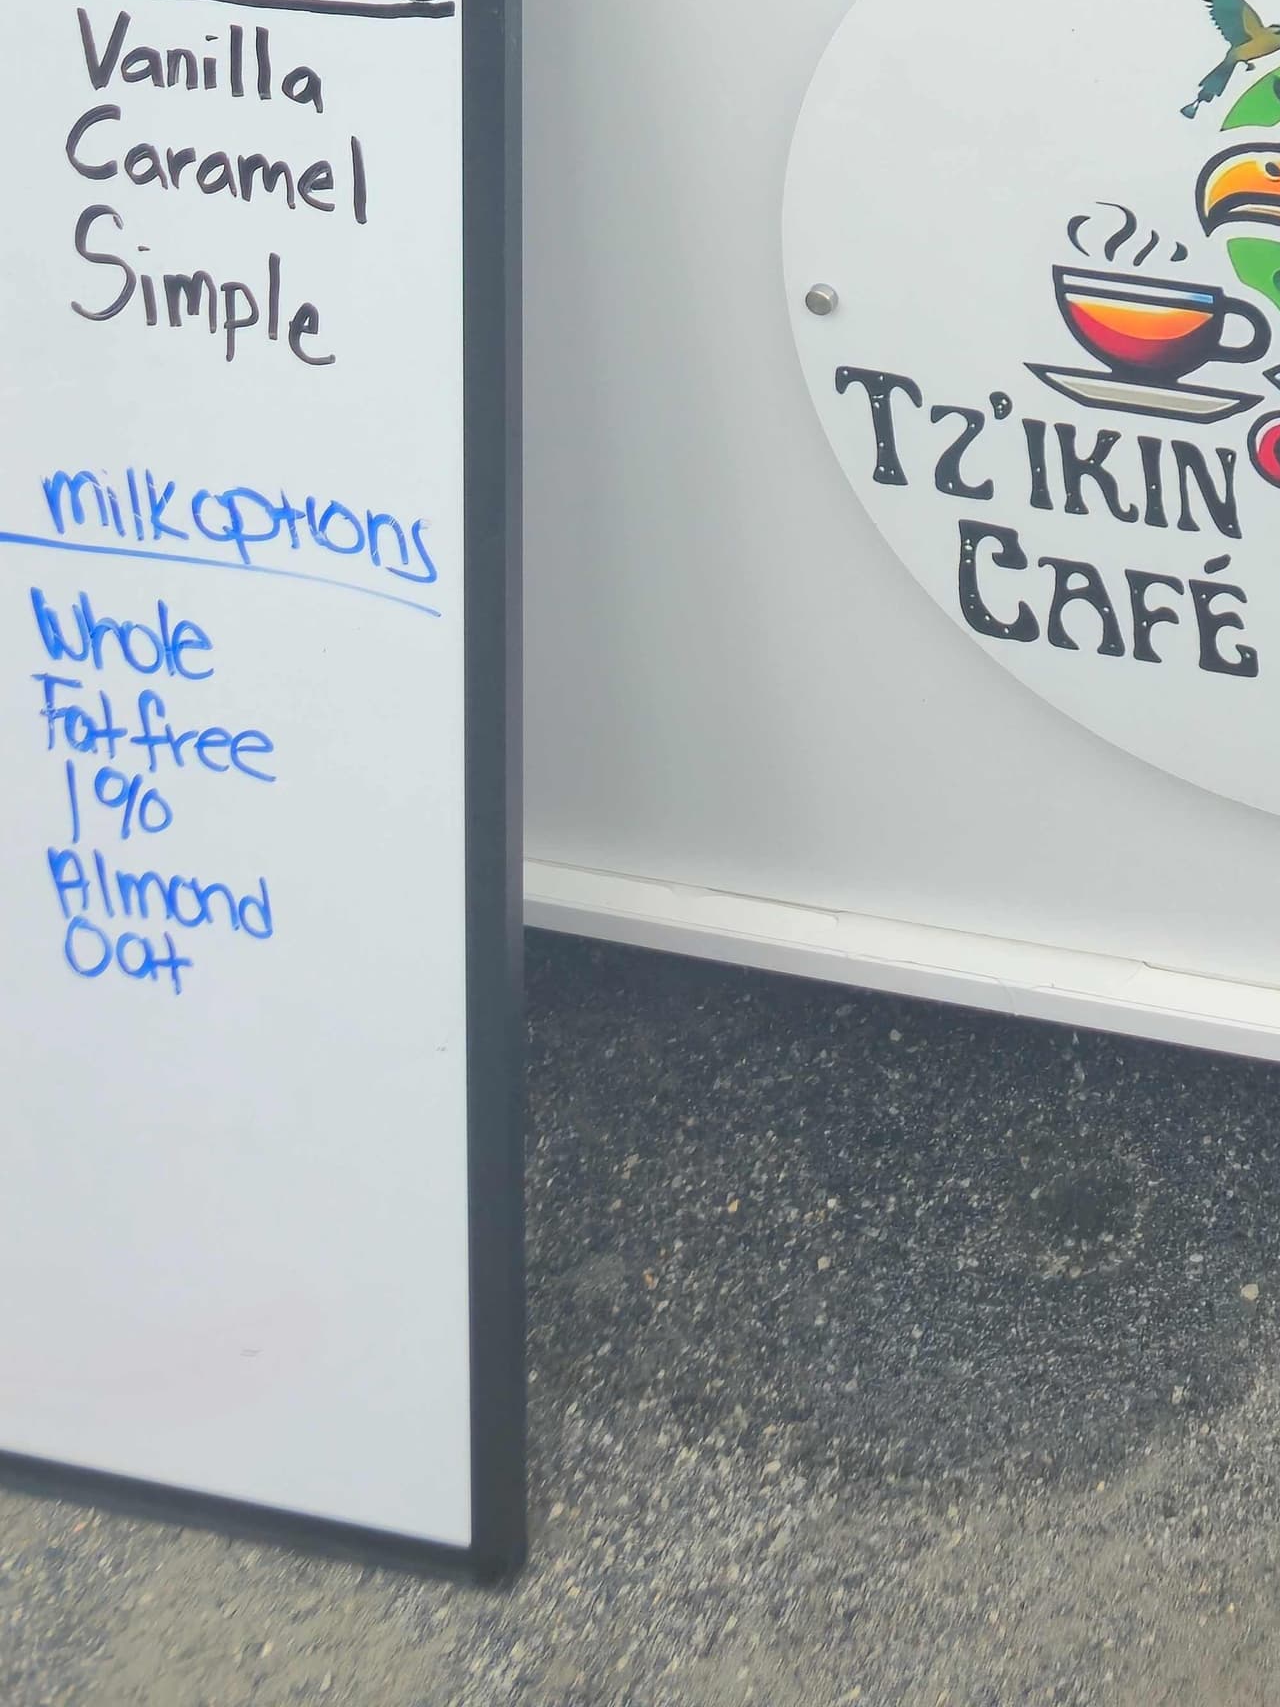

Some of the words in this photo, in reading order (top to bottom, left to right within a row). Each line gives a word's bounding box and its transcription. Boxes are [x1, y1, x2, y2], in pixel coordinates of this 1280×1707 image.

[77, 7, 324, 114] Vanilla
[65, 104, 367, 224] Caramel
[71, 203, 336, 366] Simple
[30, 586, 214, 680] Whole
[958, 518, 1260, 679] CAFÉ
[65, 759, 173, 843] 1%
[47, 846, 273, 939] Almond
[64, 915, 193, 995] Oat
